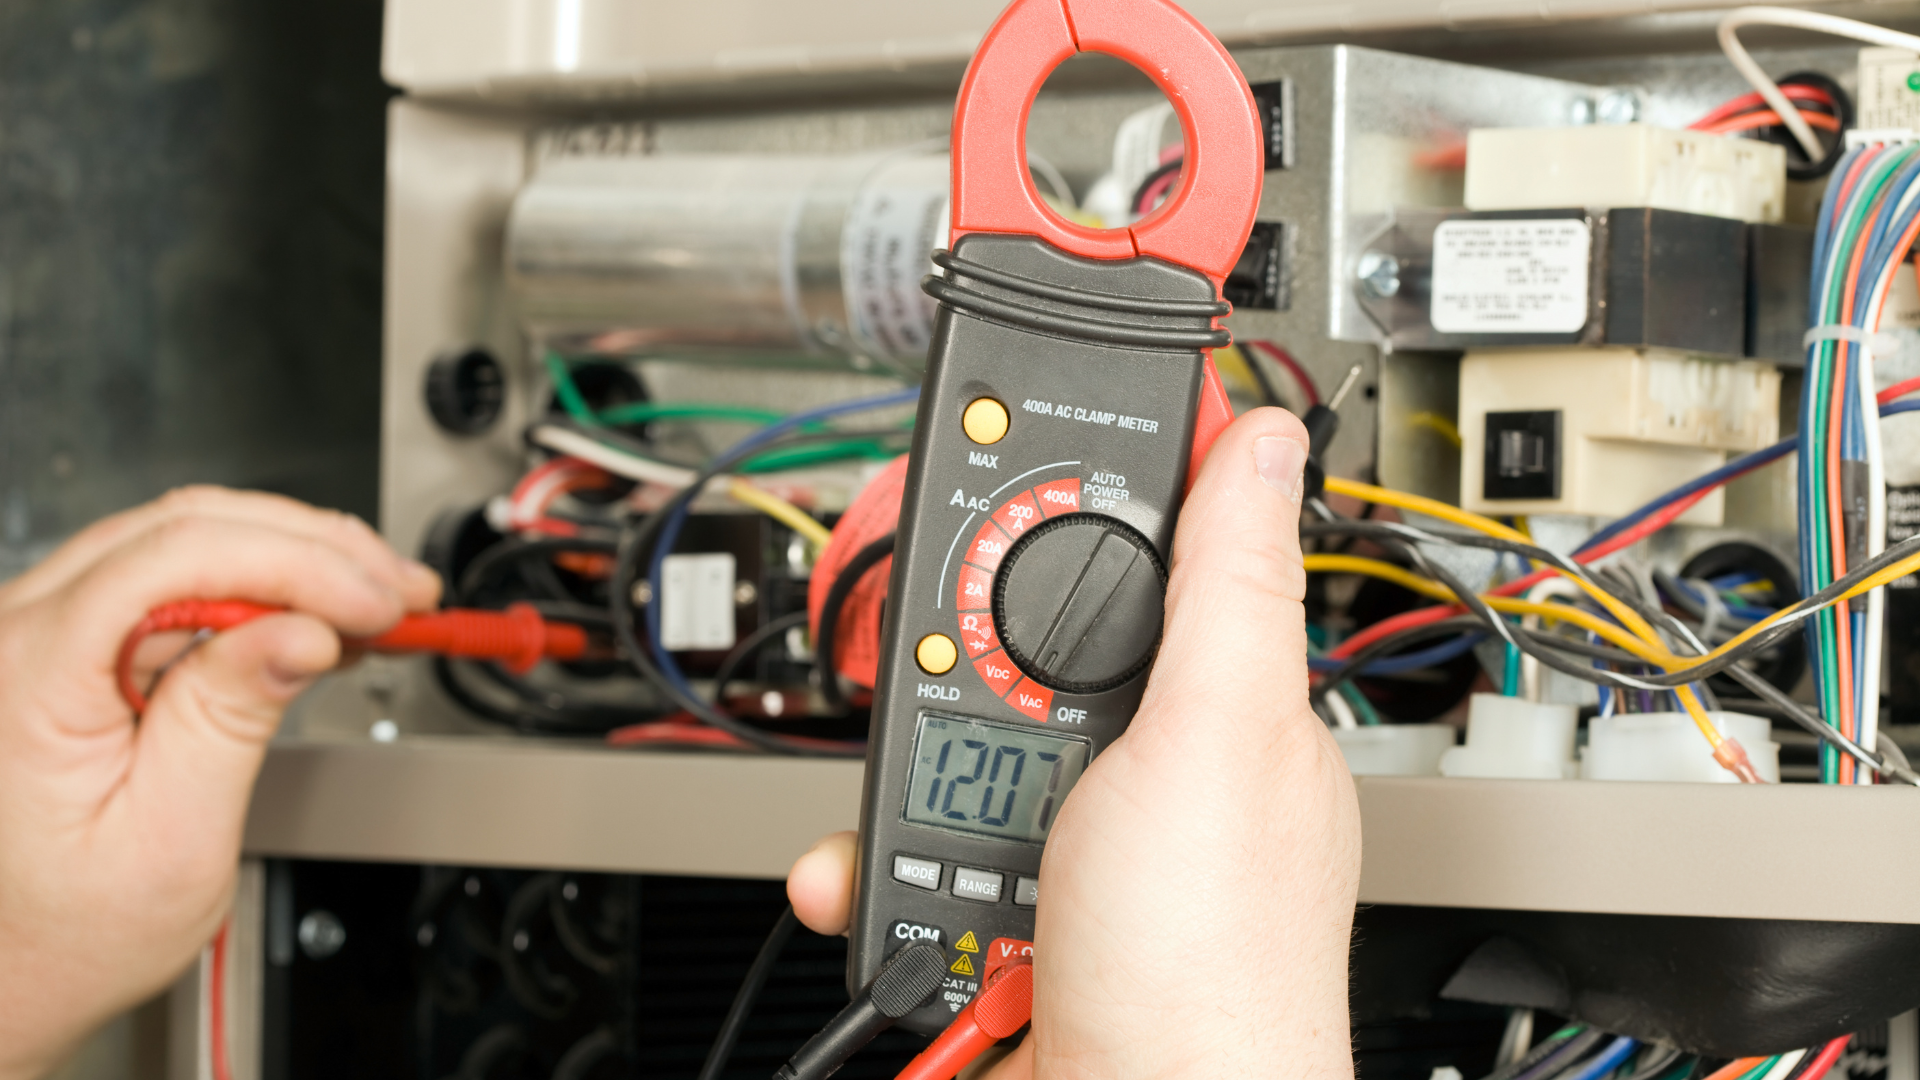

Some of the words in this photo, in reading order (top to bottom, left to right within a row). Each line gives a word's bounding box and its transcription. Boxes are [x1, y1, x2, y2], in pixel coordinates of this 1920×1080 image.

[1022, 399, 1052, 416] 400A
[1054, 404, 1072, 419] AC
[1074, 407, 1116, 426] CLAMP
[1117, 415, 1159, 433] METER
[968, 451, 999, 469] MAX
[1090, 471, 1126, 488] AUTO
[1043, 489, 1077, 506] 400A
[1083, 483, 1130, 501] POWER
[1008, 503, 1033, 519] 200
[1091, 497, 1117, 511] OFF
[1013, 517, 1024, 531] A
[977, 539, 1001, 553] 20A
[965, 583, 983, 597] 2A
[917, 683, 960, 701] HOLD
[1057, 707, 1088, 725] OFF
[927, 720, 947, 730] AUTO
[920, 756, 931, 765] AC
[901, 864, 936, 881] MODE
[959, 878, 998, 896] RANGE
[895, 923, 940, 942] COM
[942, 977, 966, 990] CAT
[967, 982, 978, 993] III
[943, 991, 971, 1004] 600V
